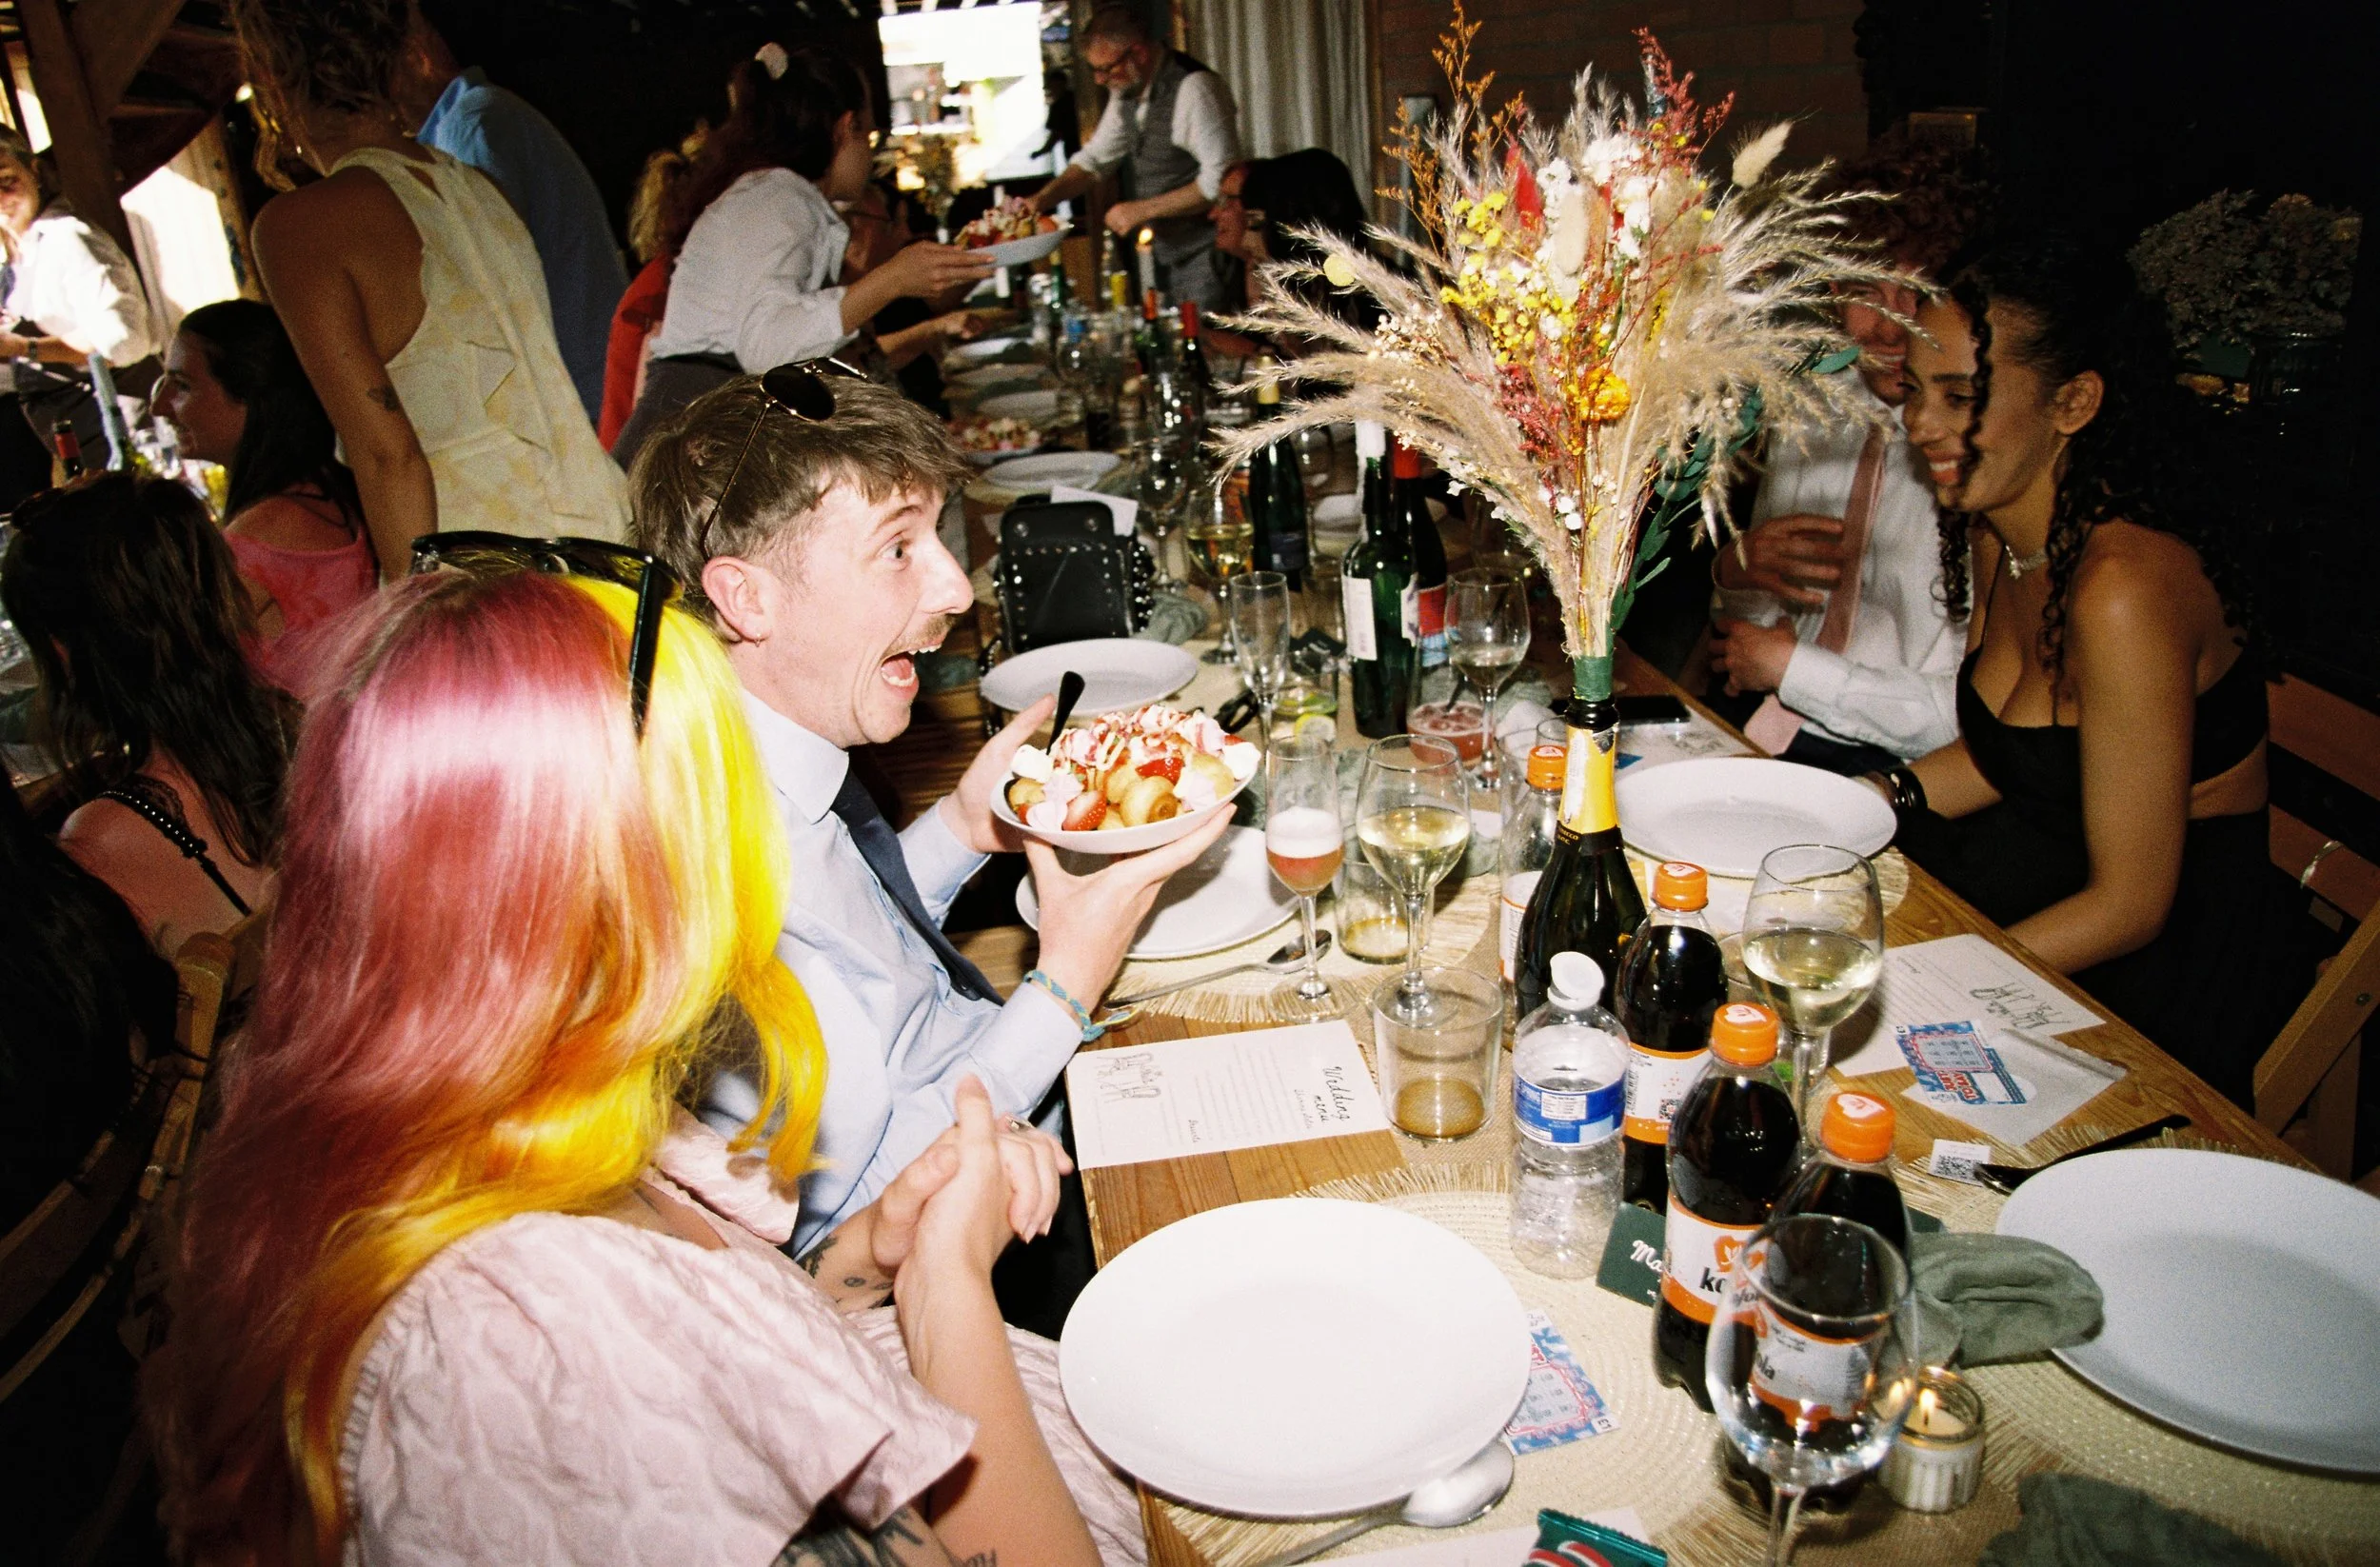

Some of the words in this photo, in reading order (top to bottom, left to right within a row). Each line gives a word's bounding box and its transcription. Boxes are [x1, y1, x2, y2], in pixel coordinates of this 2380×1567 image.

[1322, 1065, 1355, 1122] Wedding
[1935, 1070, 1958, 1092] JUST
[1961, 1087, 1980, 1101] TO
[1314, 1094, 1330, 1123] menu
[1629, 1239, 1664, 1273] Ma
